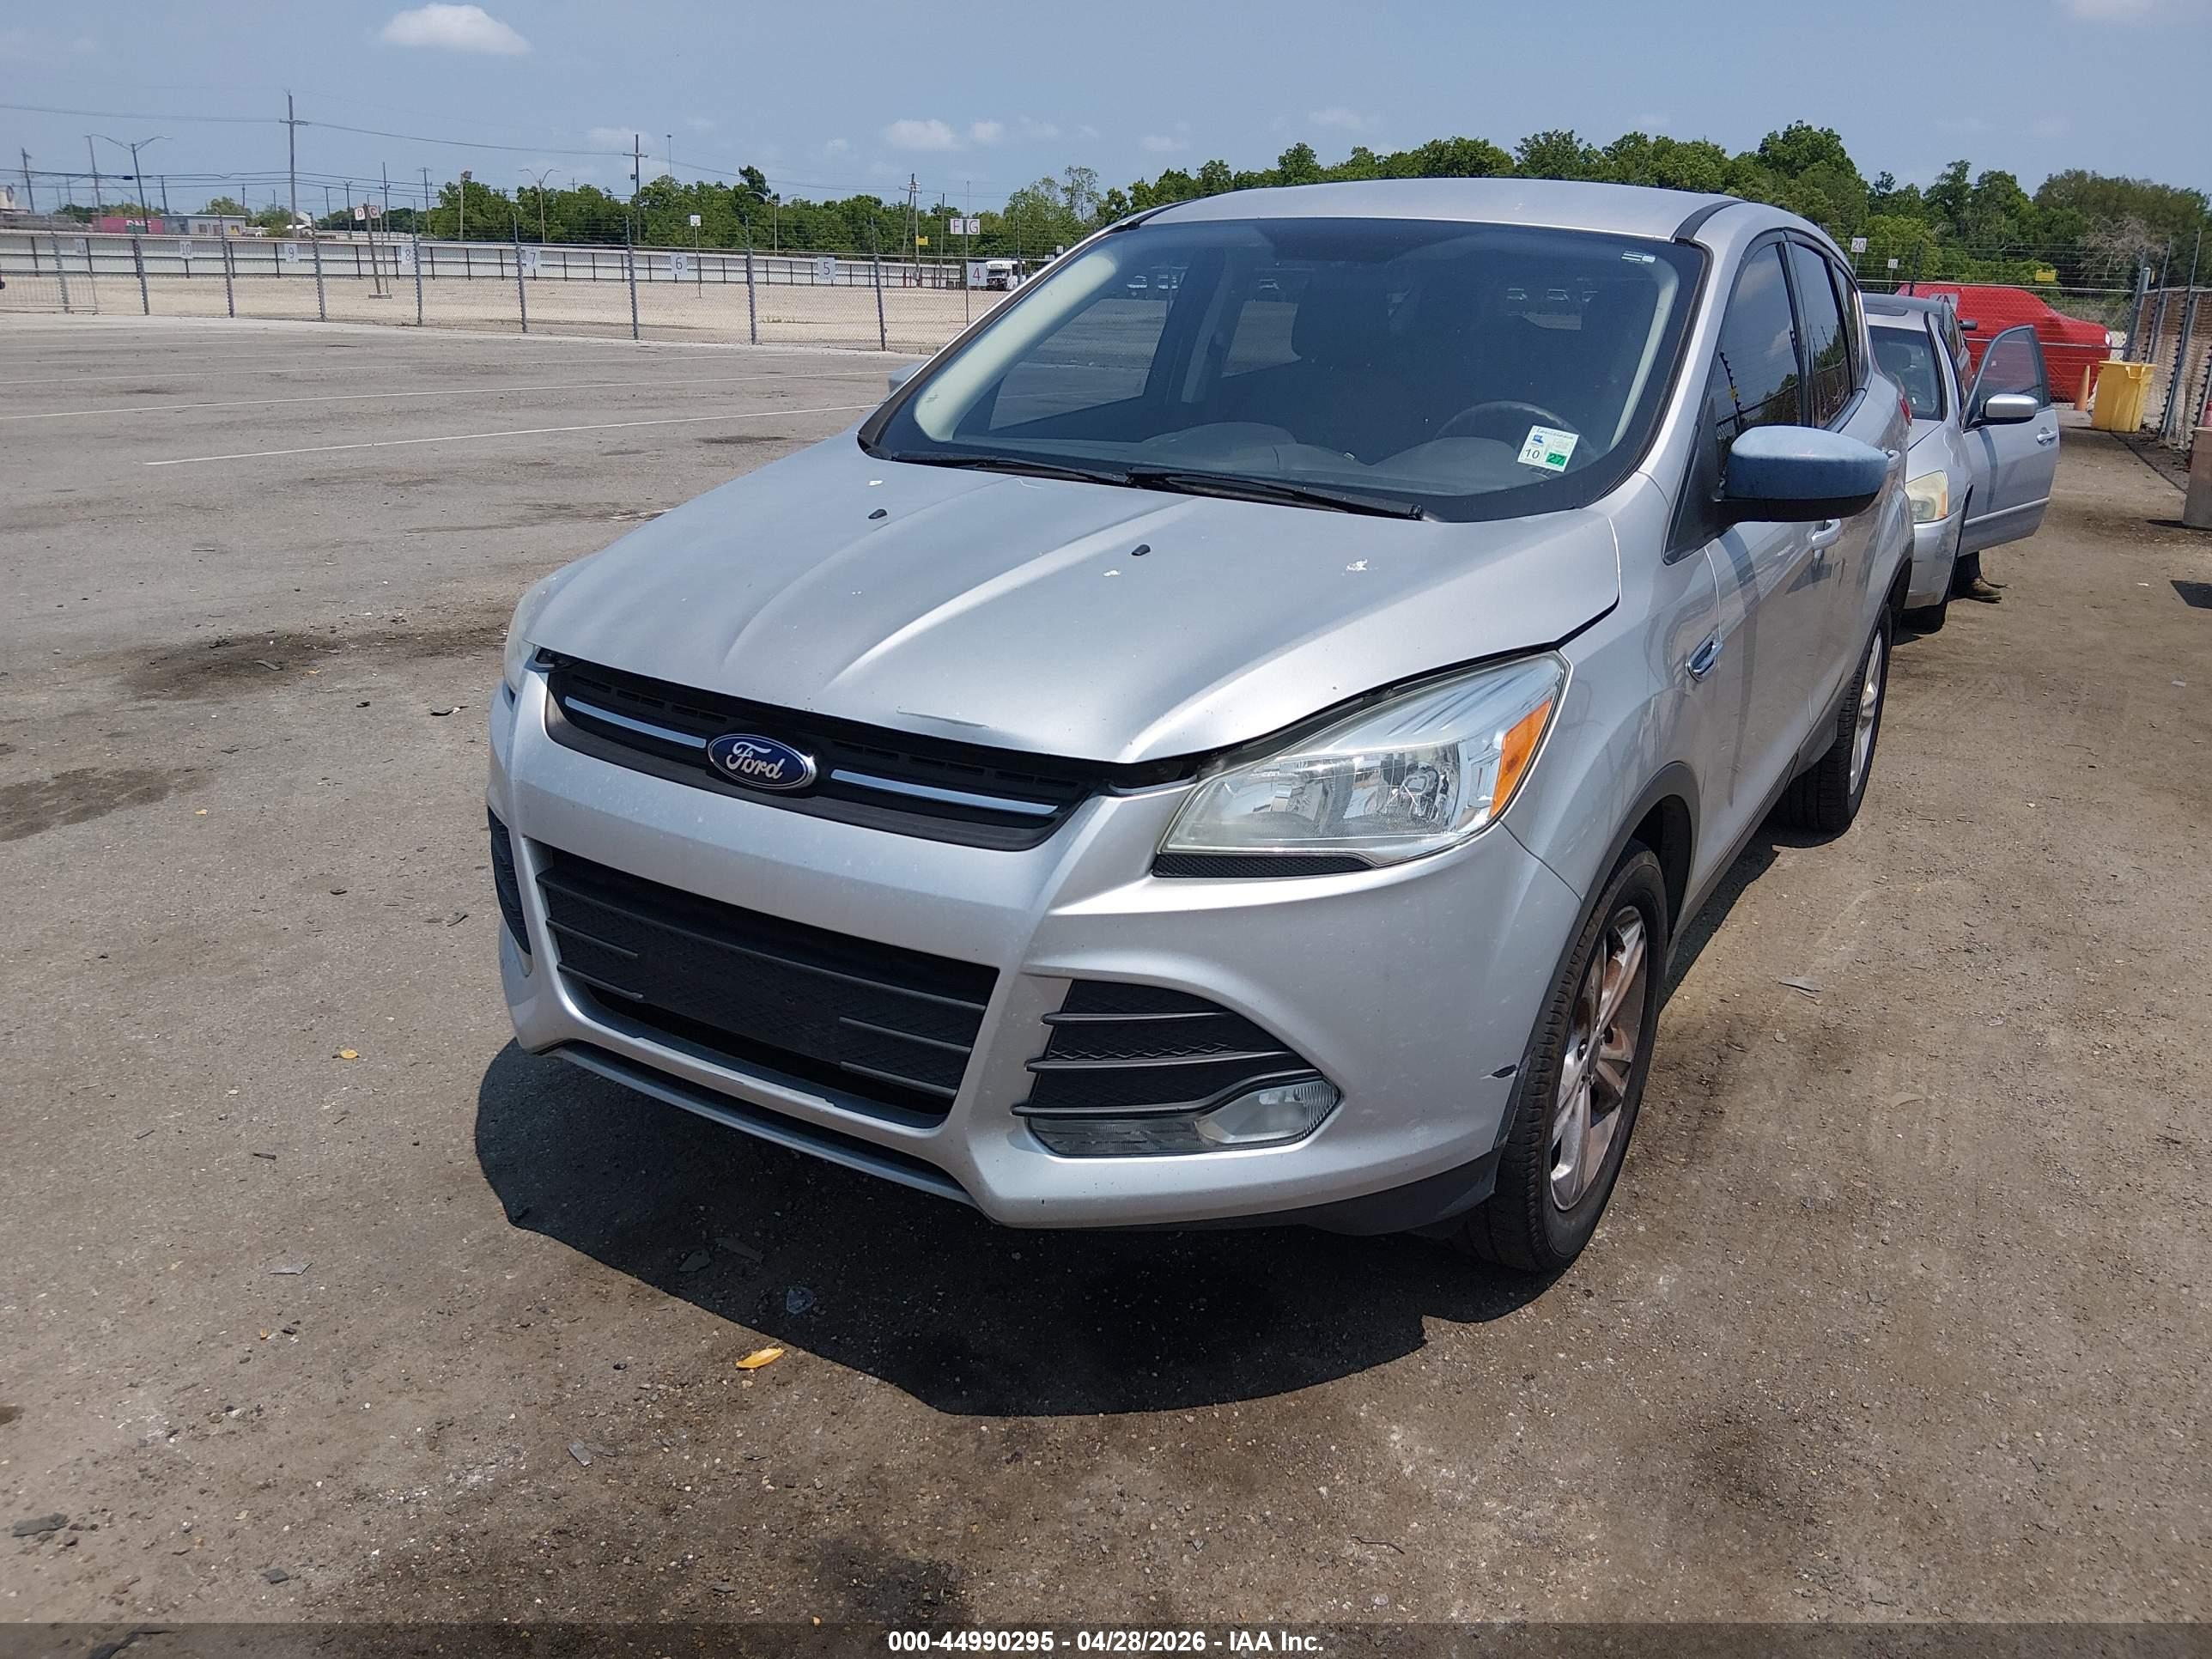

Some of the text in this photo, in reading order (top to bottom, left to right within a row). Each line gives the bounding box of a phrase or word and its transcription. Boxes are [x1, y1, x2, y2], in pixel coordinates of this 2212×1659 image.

[357, 210, 363, 218] D
[370, 206, 377, 216] C
[952, 220, 960, 234] F
[969, 220, 979, 234] G
[181, 244, 191, 256] 10
[288, 246, 295, 258] 9
[1852, 240, 1865, 251] 20
[404, 249, 411, 261] 8
[530, 252, 537, 265] 7
[675, 257, 683, 270] 6
[823, 261, 830, 275] 5
[972, 267, 981, 282] 4
[1524, 448, 1565, 465] 10 27
[726, 741, 786, 780] Ford
